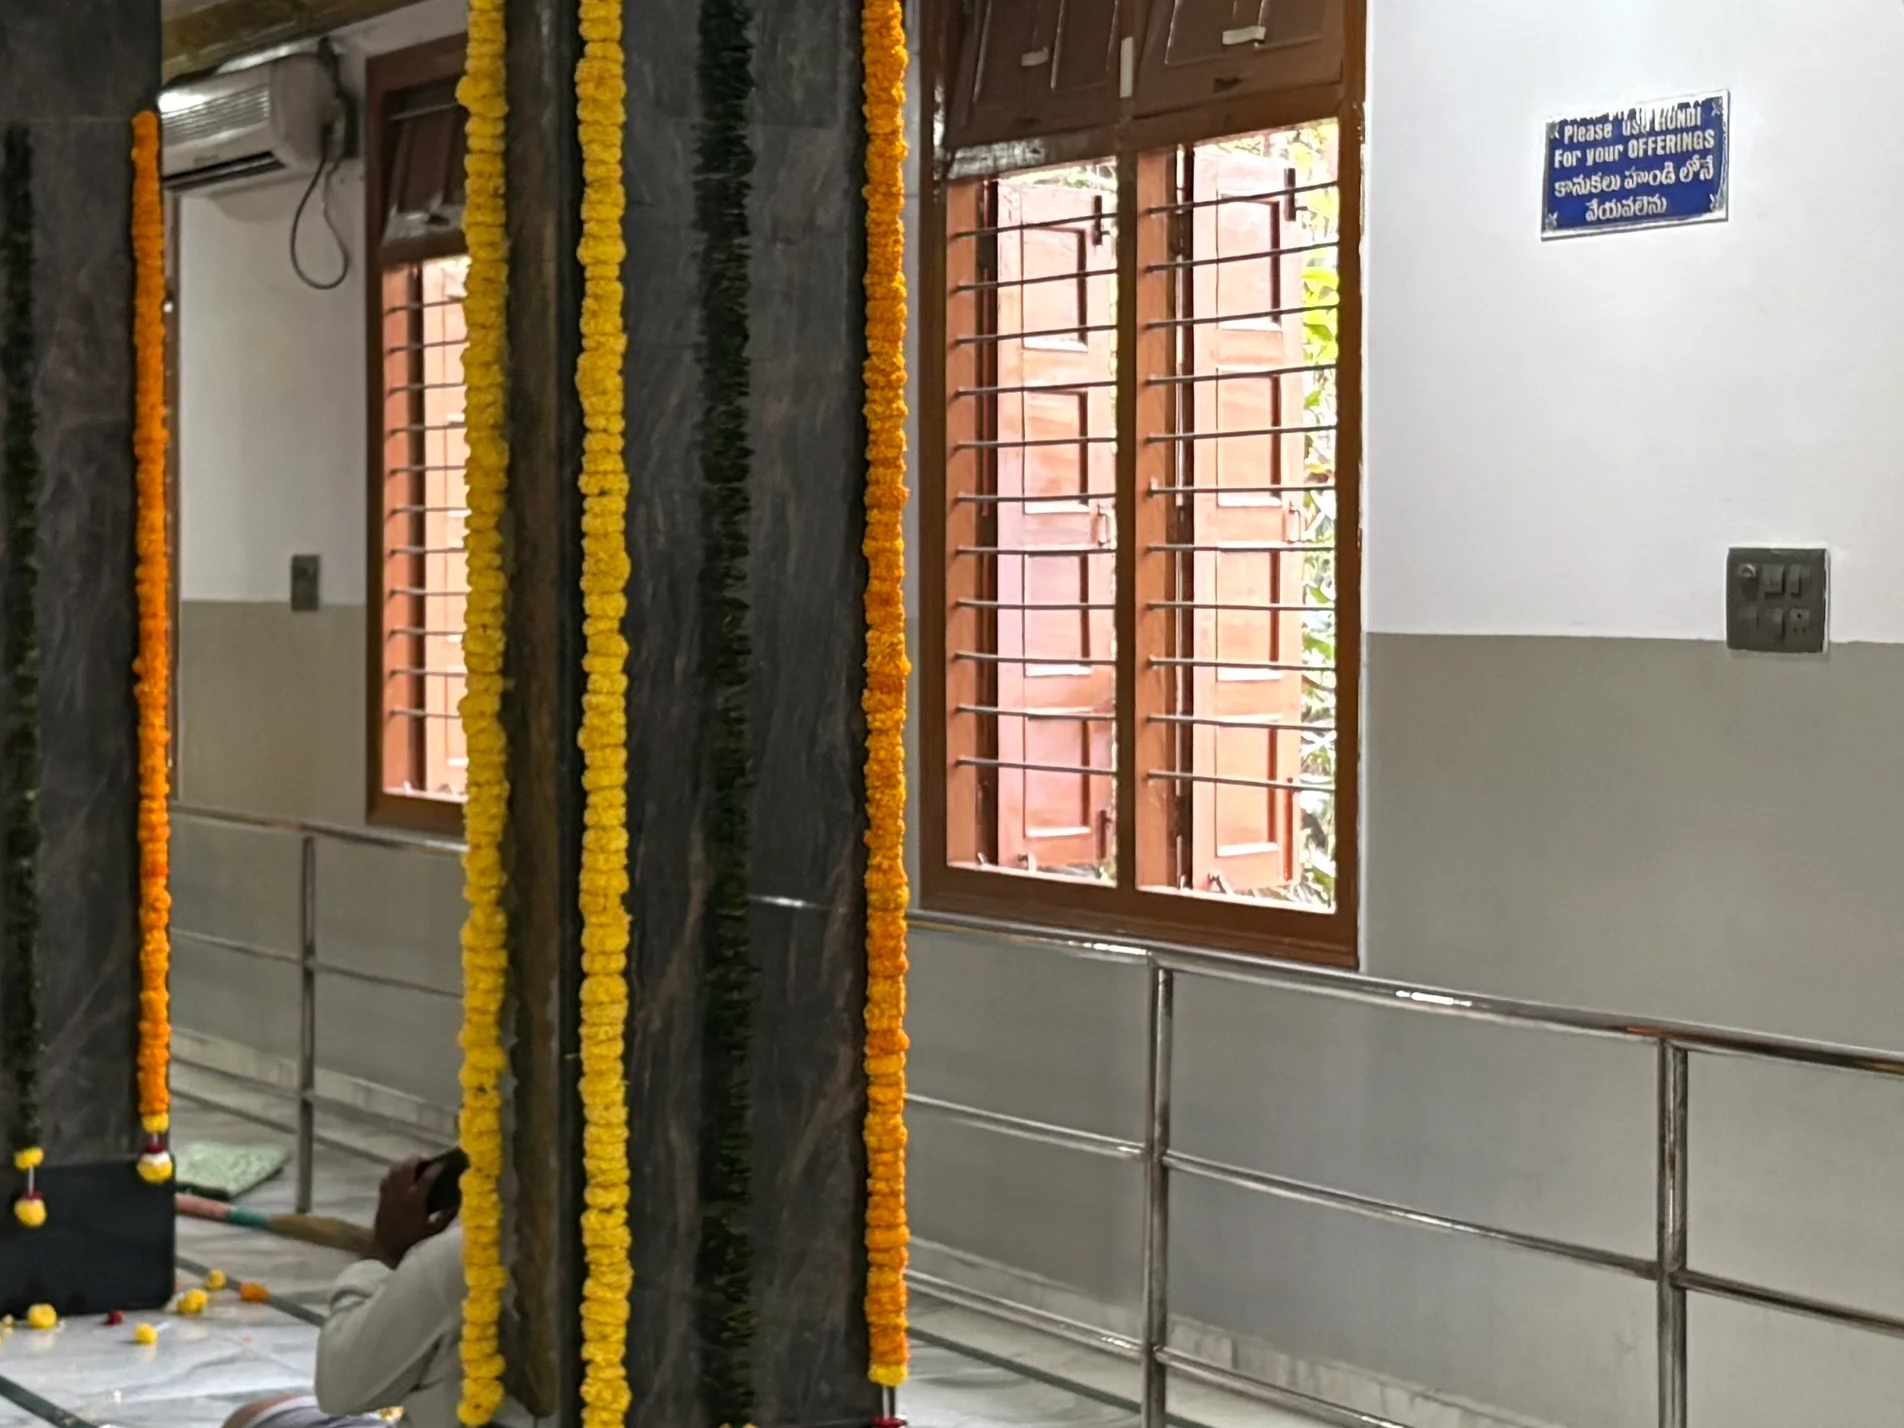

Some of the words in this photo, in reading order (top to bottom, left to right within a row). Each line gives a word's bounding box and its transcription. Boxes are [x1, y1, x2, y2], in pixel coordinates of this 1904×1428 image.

[1564, 122, 1612, 144] Please
[1554, 149, 1582, 168] For
[1585, 143, 1623, 166] your
[1628, 129, 1715, 159] OFFERINGS
[1554, 172, 1621, 198] కానుకలు
[1585, 193, 1667, 222] వేయవలెను
